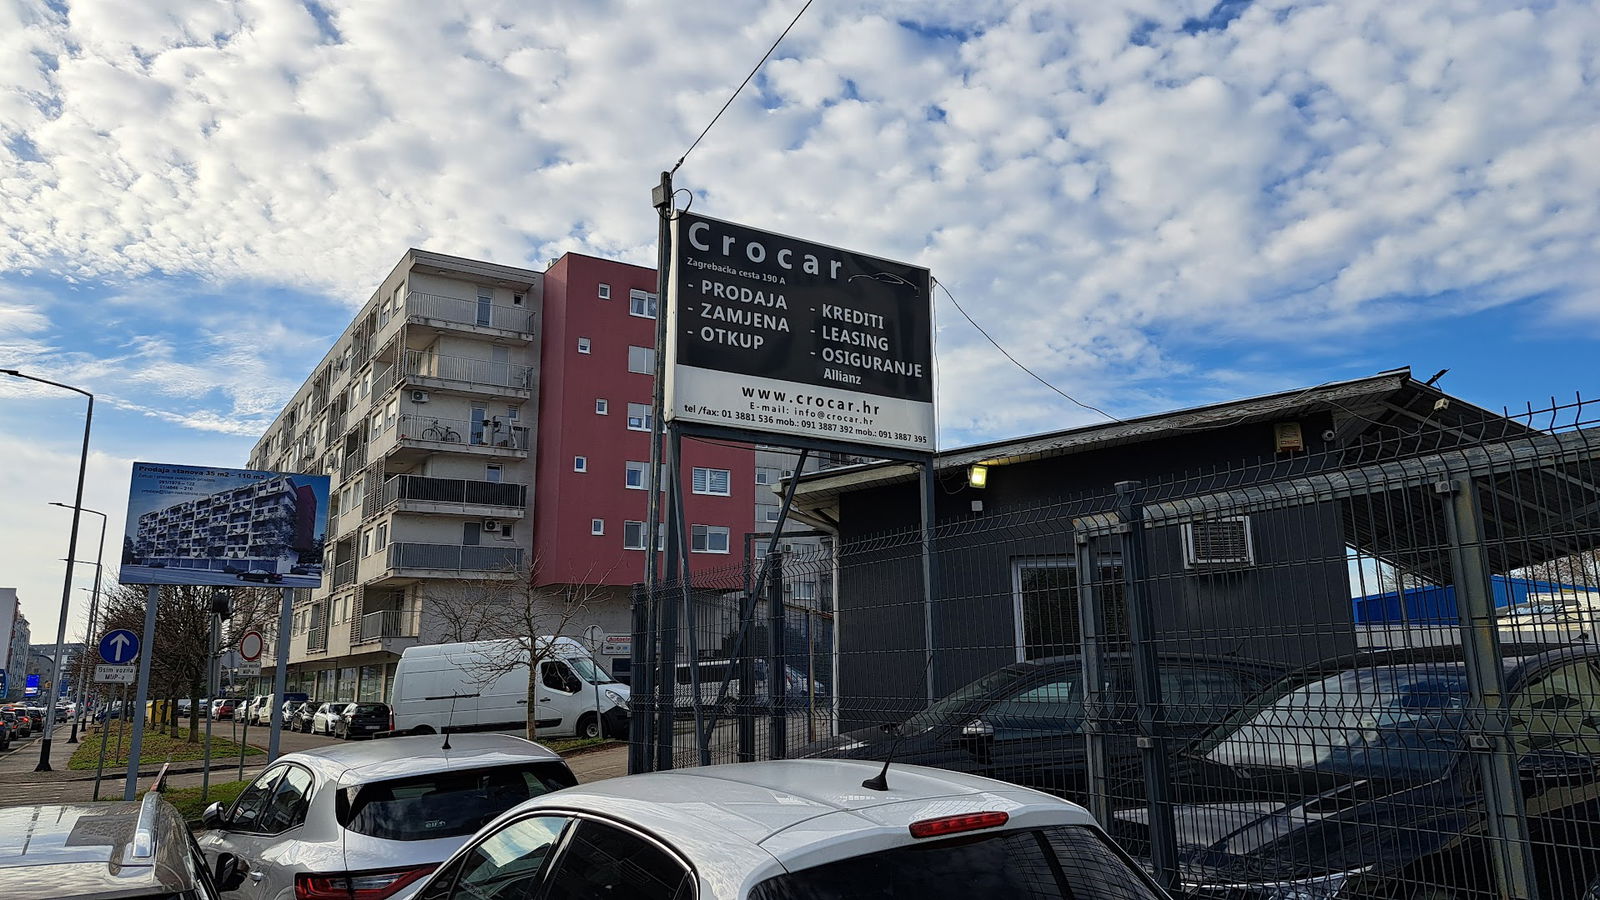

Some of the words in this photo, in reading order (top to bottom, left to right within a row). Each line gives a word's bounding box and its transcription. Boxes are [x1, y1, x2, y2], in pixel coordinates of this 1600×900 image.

[688, 221, 842, 279] Crocar
[738, 270, 760, 280] cesta
[762, 273, 778, 283] 190
[779, 277, 786, 285] A
[701, 279, 788, 310] PRODAJA
[700, 302, 790, 333] ZAMJENA
[822, 303, 884, 330] KREDITI
[700, 326, 764, 350] OTKUP
[822, 325, 889, 351] LEASING
[822, 347, 923, 378] OSIGURANJE
[823, 367, 862, 385] Allianz
[741, 386, 880, 415] www.crocar.hr
[749, 401, 790, 414] E-mail:
[794, 407, 874, 425] info@crocar.hr
[684, 404, 696, 413] tel
[698, 406, 720, 417] /fax:
[721, 409, 732, 418] 01
[735, 411, 756, 422] 3881
[758, 414, 774, 424] 536
[775, 418, 800, 427] mob.:
[801, 420, 816, 429] 091
[819, 422, 837, 432] 3887
[839, 425, 854, 434] 392
[855, 428, 877, 437] mob.:
[878, 430, 892, 439] 091
[894, 432, 912, 442] 3887
[914, 434, 927, 443] 395
[138, 465, 170, 474] Prodaja
[171, 468, 204, 476] stanova
